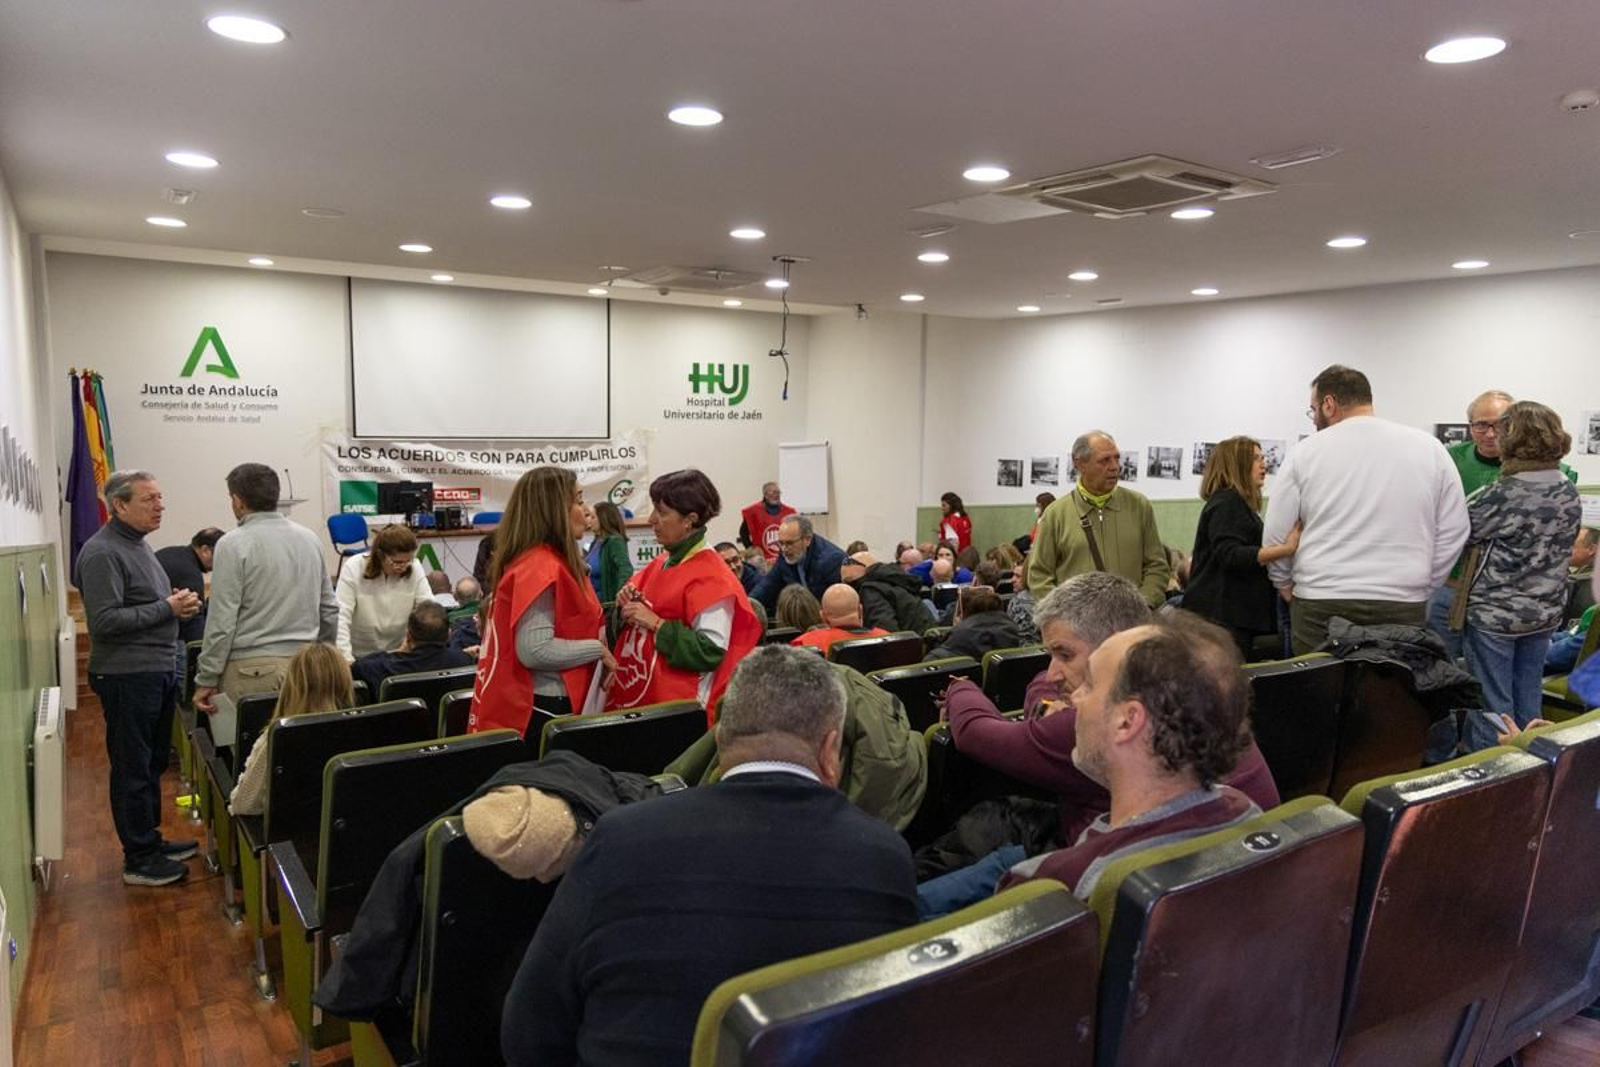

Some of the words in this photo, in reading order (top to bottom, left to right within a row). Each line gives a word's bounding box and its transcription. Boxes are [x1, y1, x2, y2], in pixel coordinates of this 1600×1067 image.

[688, 362, 749, 406] HUJ
[140, 383, 183, 396] Junta
[187, 384, 205, 396] de
[208, 384, 279, 397] Andalucía
[204, 402, 229, 410] Salud
[231, 403, 237, 411] y
[686, 397, 726, 408] Hospital
[663, 409, 726, 420] Universitario
[727, 410, 739, 420] de
[741, 409, 763, 420] Jaén
[338, 446, 372, 459] LOS
[377, 447, 466, 464] ACUERDOS
[470, 452, 501, 464] SON
[506, 451, 545, 464] PARA
[549, 446, 637, 463] CUMPLIRLOS
[451, 467, 491, 476] ACUERDO
[613, 487, 636, 498] CSIF
[343, 504, 377, 513] SATSE
[923, 943, 949, 959] 12
